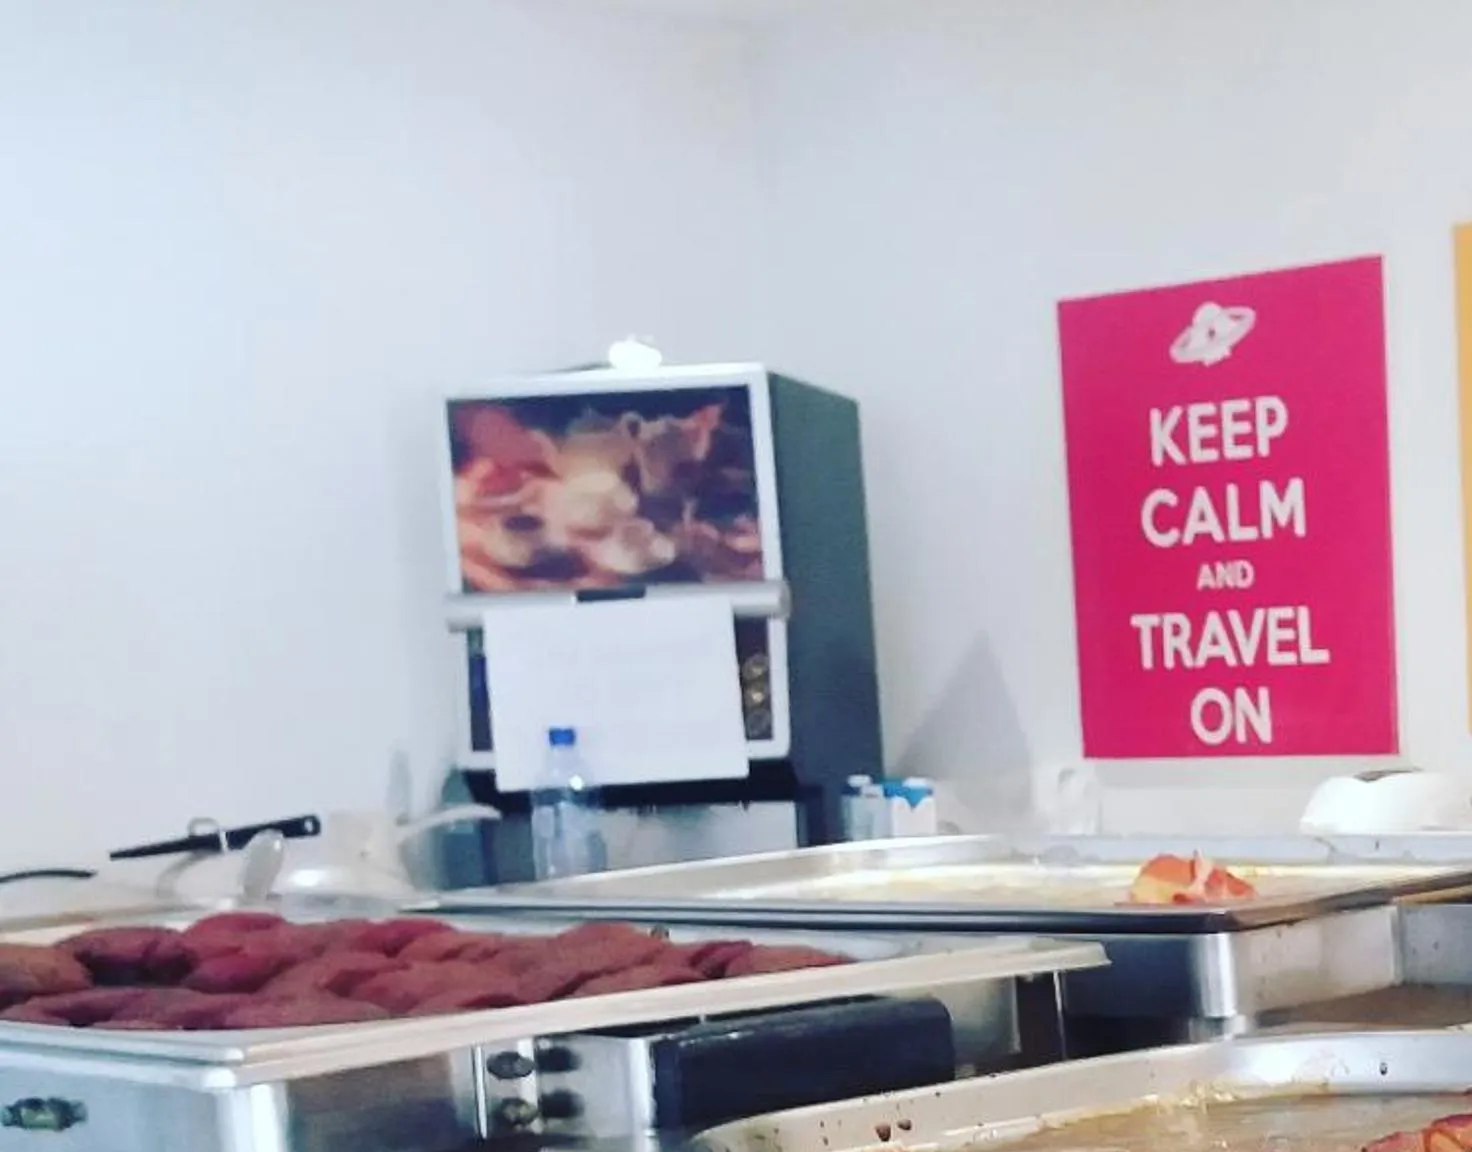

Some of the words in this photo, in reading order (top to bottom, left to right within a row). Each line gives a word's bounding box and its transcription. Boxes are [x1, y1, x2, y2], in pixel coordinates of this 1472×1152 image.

[1149, 396, 1288, 466] KEEP
[1141, 477, 1307, 547] CALM
[1197, 560, 1255, 591] AND
[1130, 605, 1331, 670] TRAVEL
[1190, 686, 1273, 745] ON
